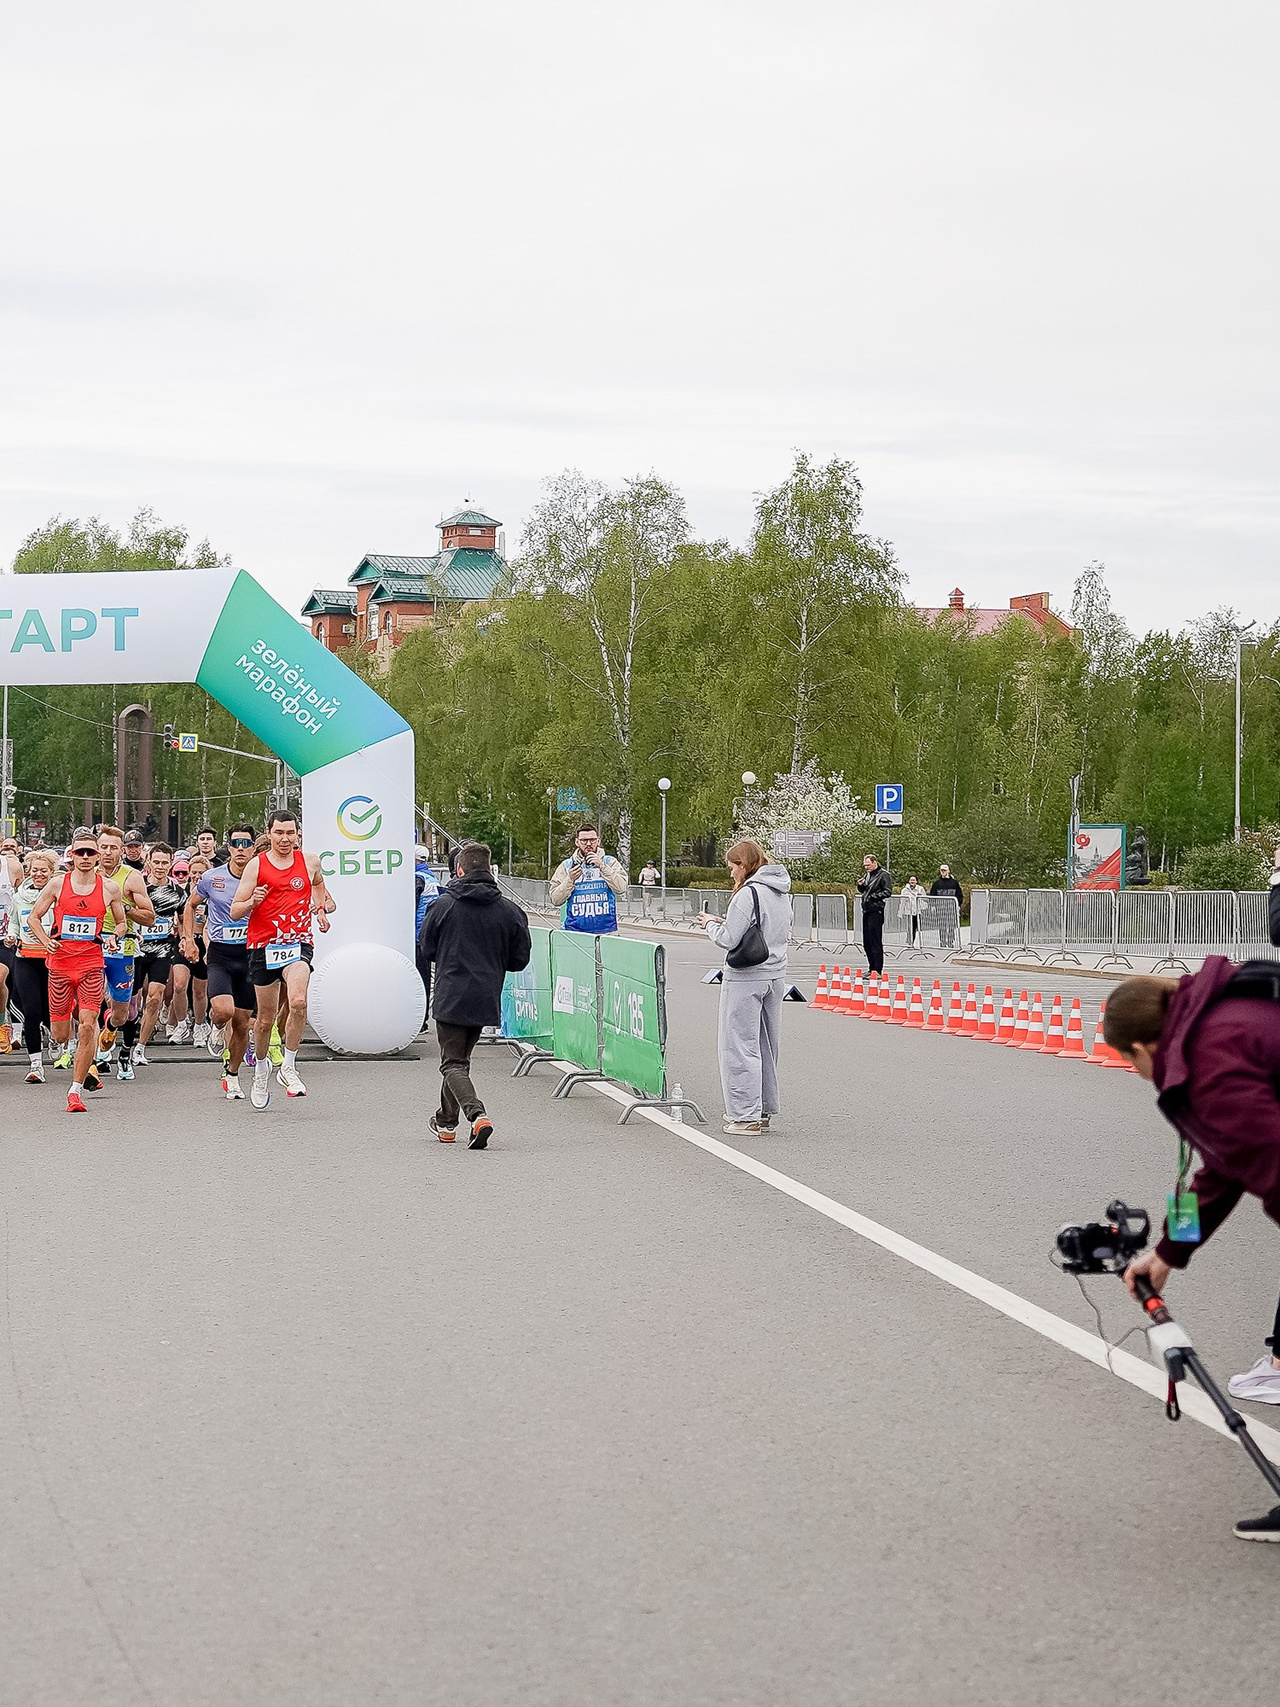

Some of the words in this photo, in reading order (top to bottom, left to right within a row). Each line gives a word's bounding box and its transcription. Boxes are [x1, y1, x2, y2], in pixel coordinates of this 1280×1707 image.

[250, 639, 341, 720] зелёный
[235, 654, 323, 735] марафон
[883, 787, 898, 810] P
[319, 849, 403, 876] СБЕР
[571, 901, 610, 918] СУДЬЯ
[573, 892, 608, 903] ГЛАВНЫЙ
[68, 922, 90, 934] 812
[628, 991, 644, 1040] 185
